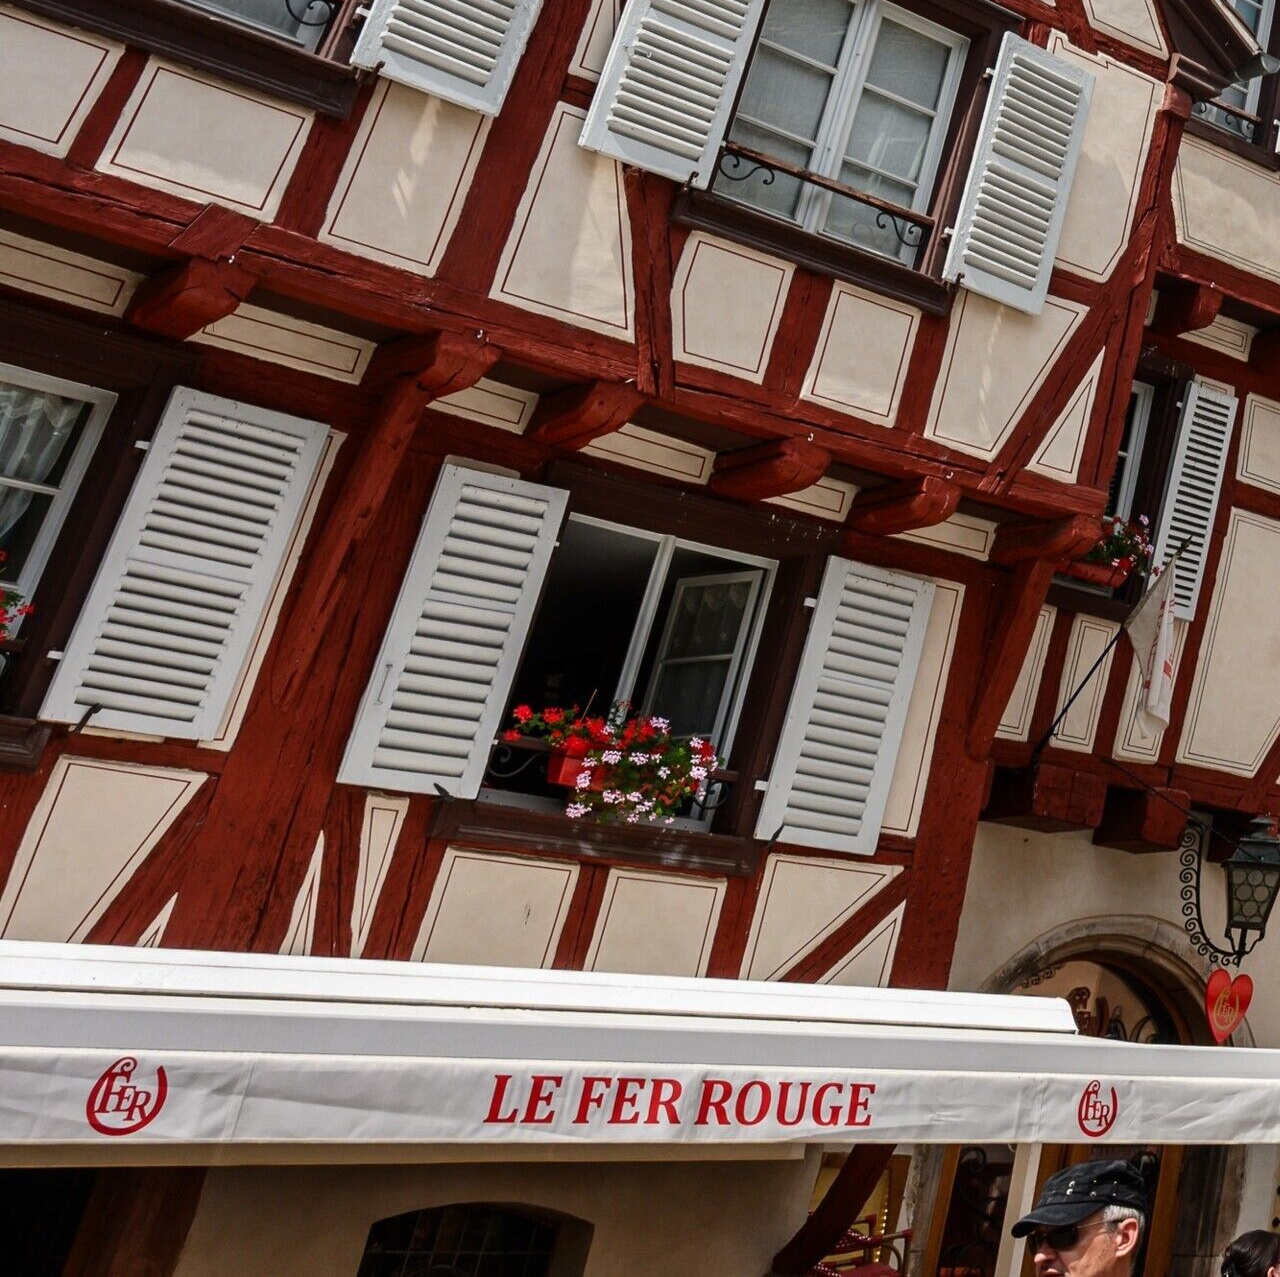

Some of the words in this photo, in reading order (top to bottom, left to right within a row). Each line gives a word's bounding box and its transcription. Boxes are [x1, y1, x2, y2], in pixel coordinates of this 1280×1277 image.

[482, 1074, 563, 1124] LE
[572, 1076, 684, 1125] FER
[694, 1079, 876, 1127] ROUGE
